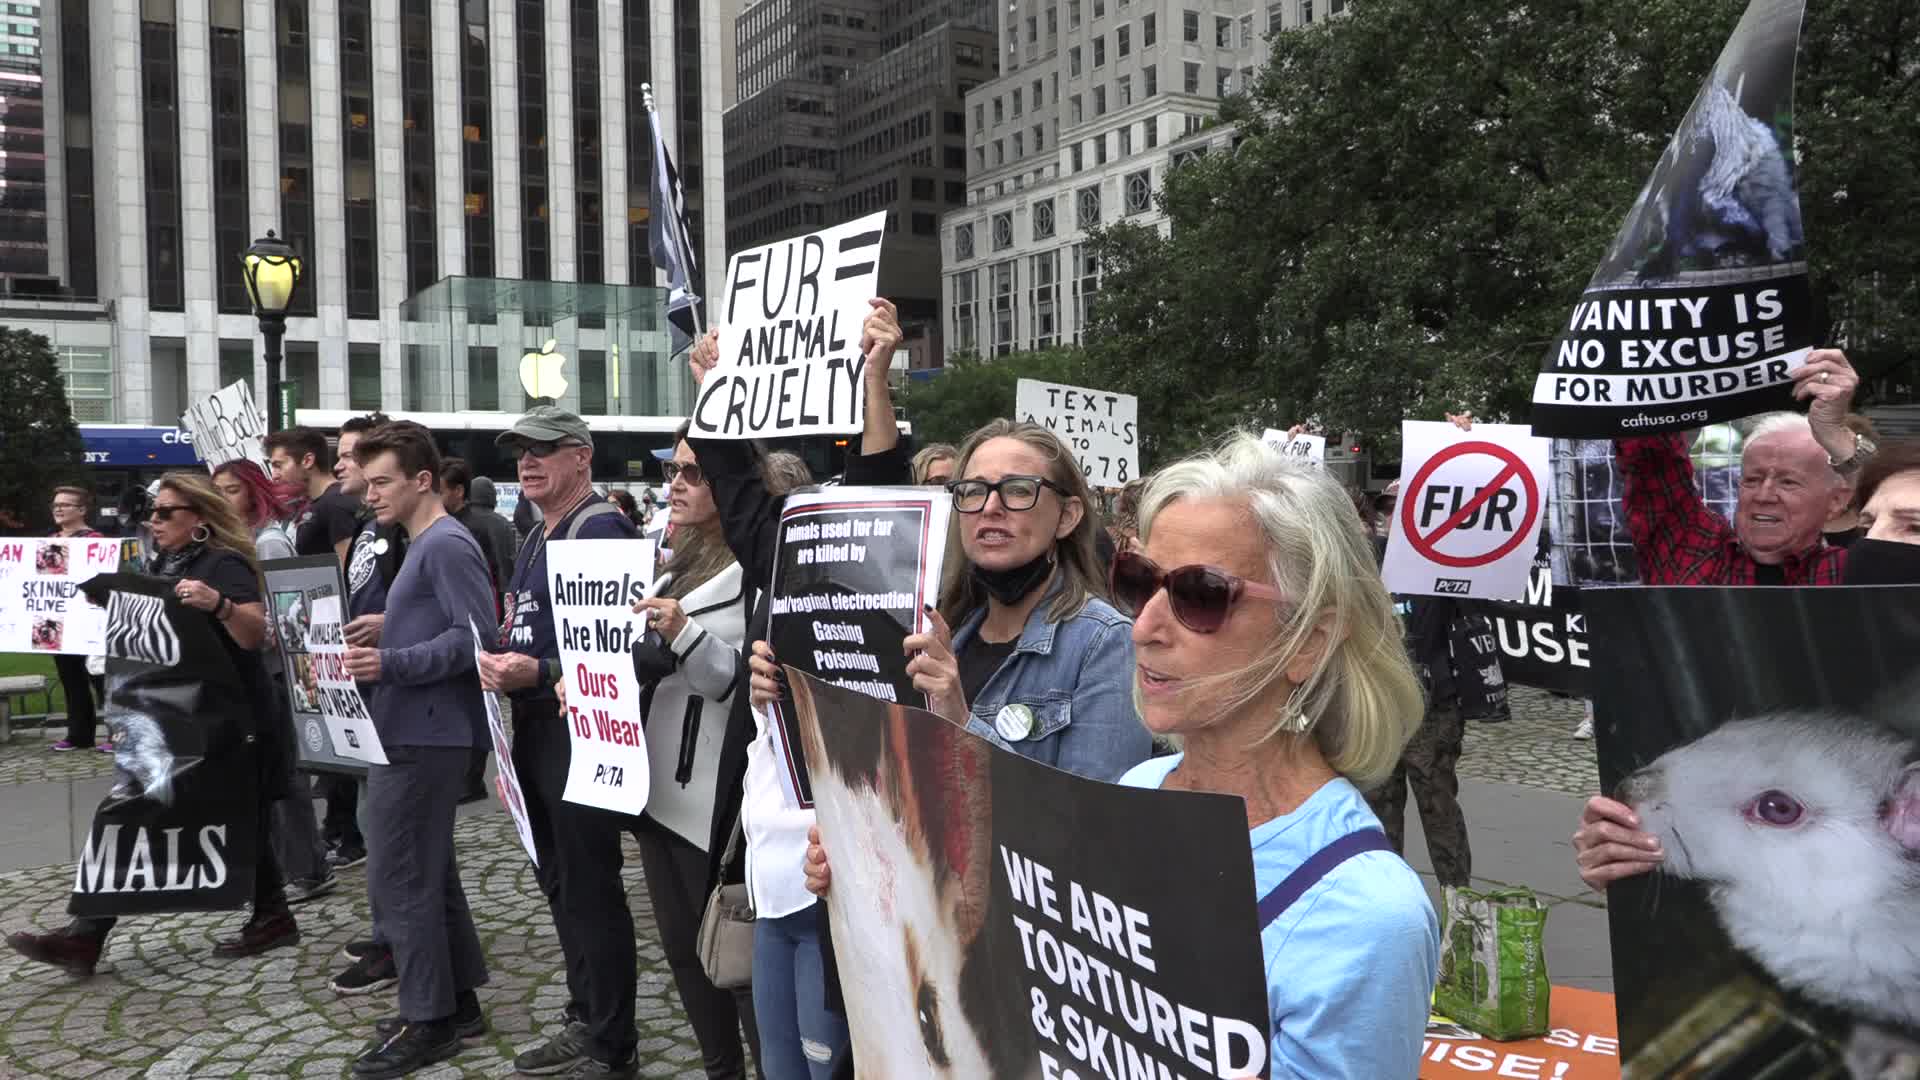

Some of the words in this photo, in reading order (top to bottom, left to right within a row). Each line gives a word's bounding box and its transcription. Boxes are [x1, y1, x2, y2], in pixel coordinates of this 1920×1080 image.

[727, 234, 824, 325] FUR
[1569, 296, 1710, 332] VANITY
[1734, 289, 1784, 325] IS
[736, 309, 846, 367] ANIMAL
[1557, 338, 1606, 369] NO
[1620, 324, 1786, 369] EXCUSE
[694, 353, 865, 435] CRUELTY
[1555, 377, 1611, 402] FOR
[1626, 359, 1790, 402] MURDER
[1046, 388, 1118, 417] TEXT
[1620, 409, 1709, 429] caftusa.org
[83, 452, 110, 463] NY
[1072, 437, 1090, 450] TO
[1291, 441, 1312, 457] FUR
[1420, 484, 1518, 532] FUR
[785, 522, 820, 543] Animals
[821, 520, 851, 540] used
[853, 519, 872, 537] for
[873, 518, 893, 537] fur
[87, 542, 117, 564] FUR
[797, 548, 814, 565] are
[815, 544, 849, 563] killed
[850, 543, 866, 563] by
[22, 581, 78, 599] SKINNED
[26, 599, 67, 612] ALIVE
[555, 573, 645, 607] Animals
[772, 593, 832, 615] Anal/vaginal
[831, 591, 914, 610] electrocution
[562, 618, 590, 652] Are
[596, 619, 633, 654] Not
[812, 620, 865, 645] Gassing
[813, 649, 880, 674] Poisoning
[576, 663, 618, 700] Ours
[327, 687, 367, 721] WEAR
[569, 706, 590, 740] To
[592, 709, 640, 747] Wear
[1000, 844, 1062, 924] WE
[1070, 880, 1157, 974] ARE
[1012, 913, 1267, 1080] TORTURED
[1030, 986, 1060, 1045] &
